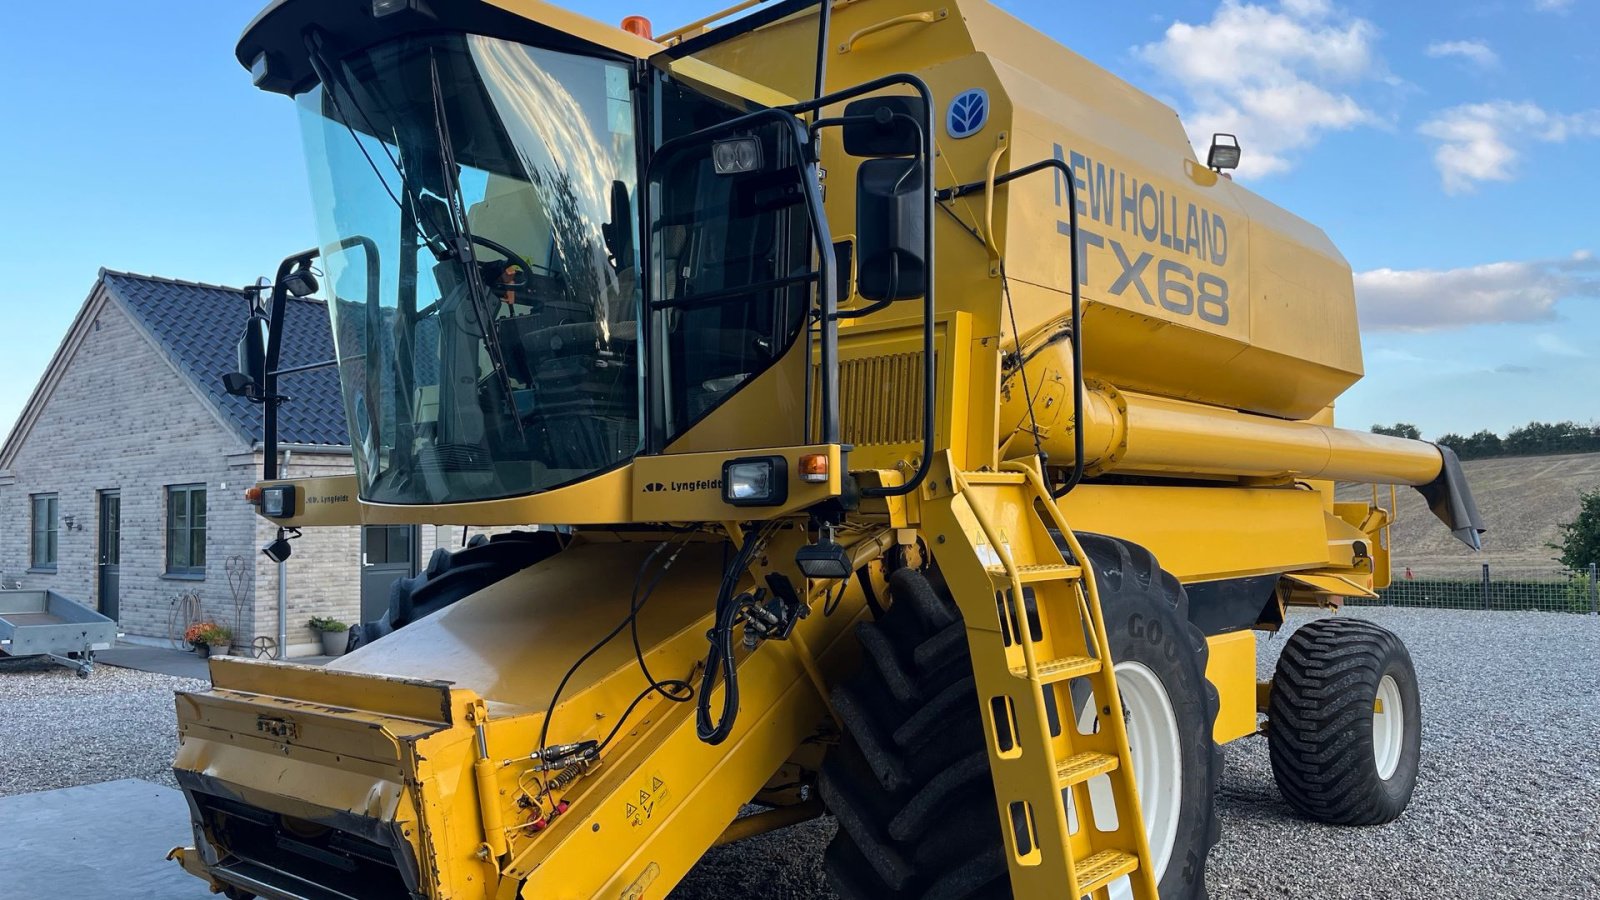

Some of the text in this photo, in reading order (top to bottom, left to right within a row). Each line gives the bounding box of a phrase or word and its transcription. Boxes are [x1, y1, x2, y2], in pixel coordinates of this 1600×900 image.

[1053, 143, 1228, 267] NEW HOLLAND
[1056, 220, 1230, 326] TX68
[671, 479, 722, 492] Lyngfeldt
